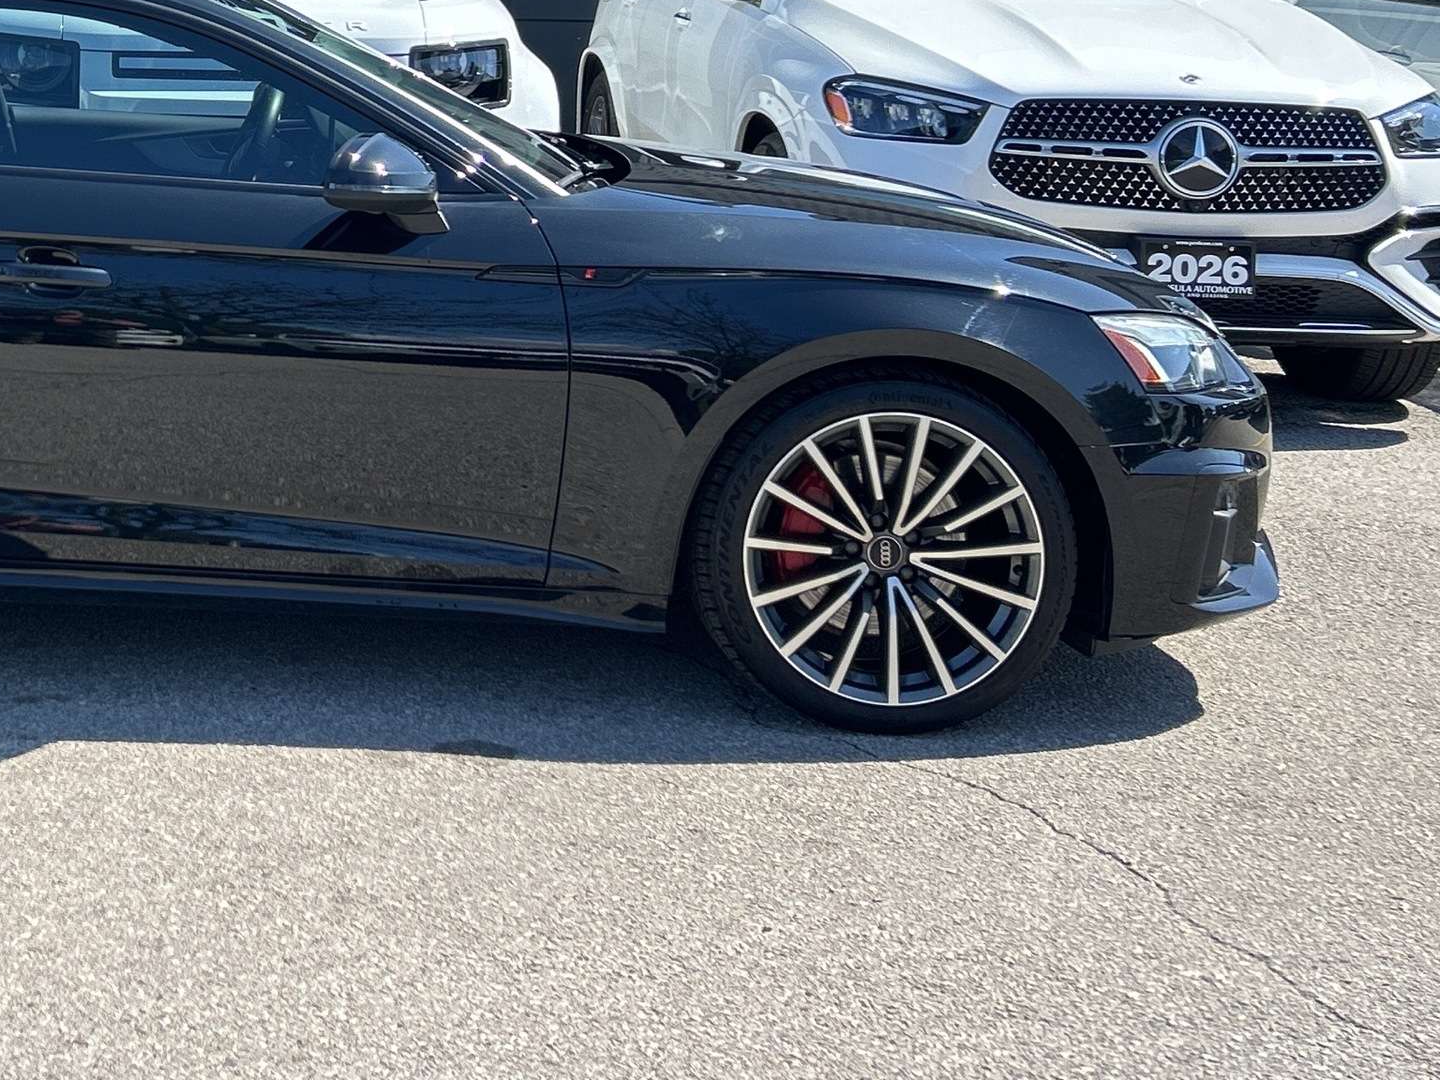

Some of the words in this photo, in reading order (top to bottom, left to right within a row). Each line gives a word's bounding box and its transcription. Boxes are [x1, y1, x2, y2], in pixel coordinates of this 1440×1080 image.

[1147, 253, 1248, 285] 2026
[1168, 284, 1191, 293] SULA
[1193, 285, 1253, 295] AUTOMOTIVE
